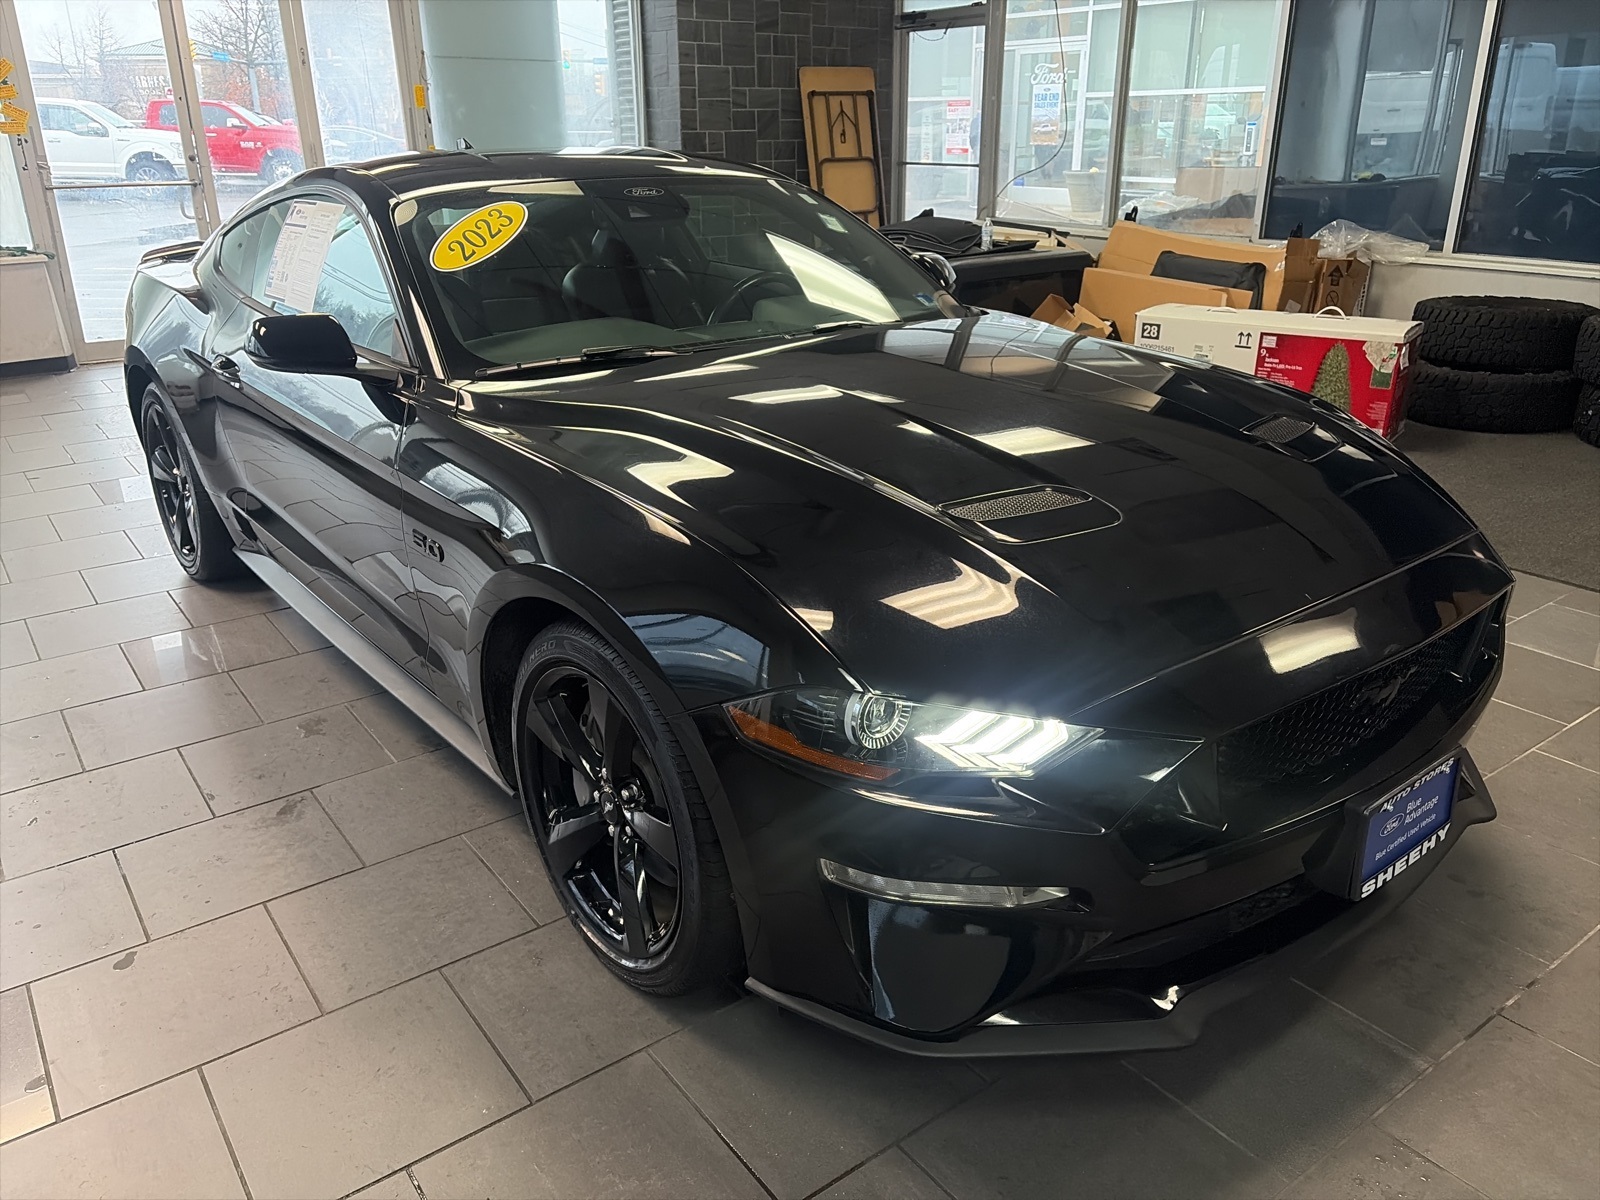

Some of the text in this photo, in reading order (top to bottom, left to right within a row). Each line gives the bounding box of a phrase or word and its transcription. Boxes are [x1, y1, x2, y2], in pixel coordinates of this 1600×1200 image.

[1030, 63, 1068, 85] Ford
[1034, 92, 1060, 101] YEAR END
[632, 188, 659, 196] Ford
[448, 208, 514, 262] 2023
[1143, 324, 1158, 338] 28
[1379, 757, 1455, 813] AUTO STORES
[1404, 795, 1439, 826] Advantage
[1406, 797, 1422, 813] Blue
[1374, 813, 1437, 861] Blue Certified Used Vehicle
[1360, 823, 1451, 899] SHEEHY
